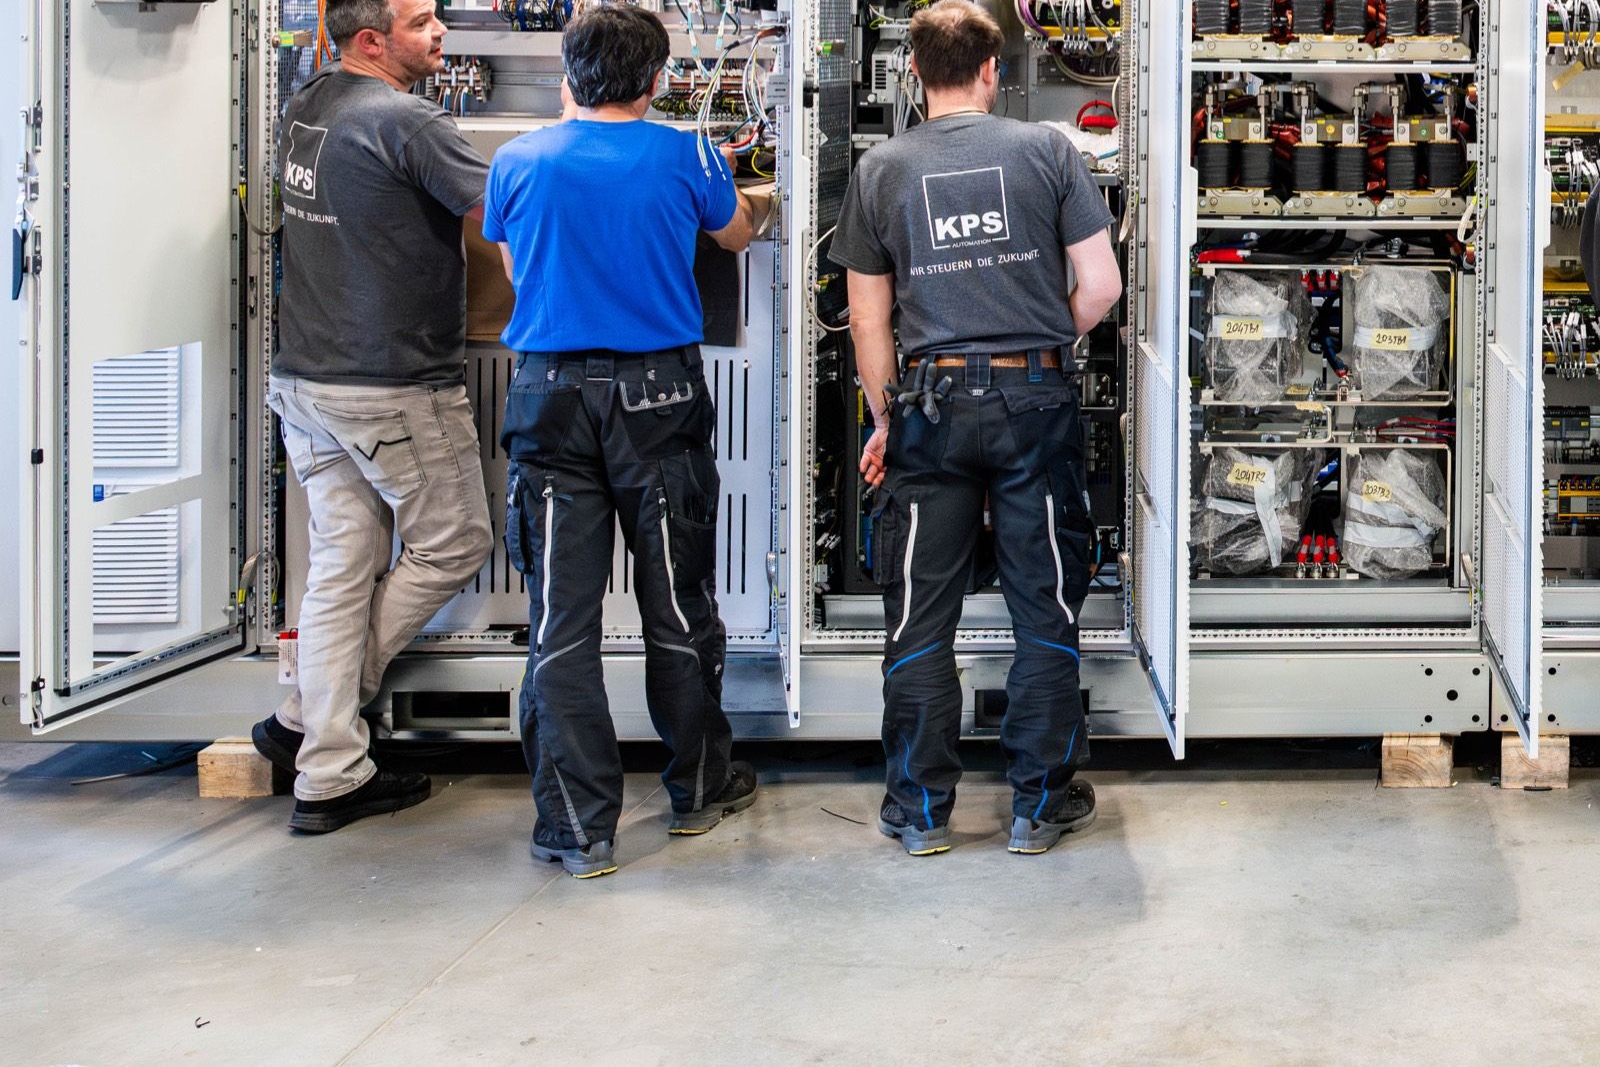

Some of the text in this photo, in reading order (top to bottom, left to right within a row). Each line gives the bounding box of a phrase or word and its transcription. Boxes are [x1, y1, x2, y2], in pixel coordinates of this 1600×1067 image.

[286, 161, 313, 191] KPS
[934, 210, 1004, 241] KPS
[951, 238, 992, 248] AUTOMATION
[927, 259, 973, 275] STEUERN
[977, 256, 994, 268] DIE
